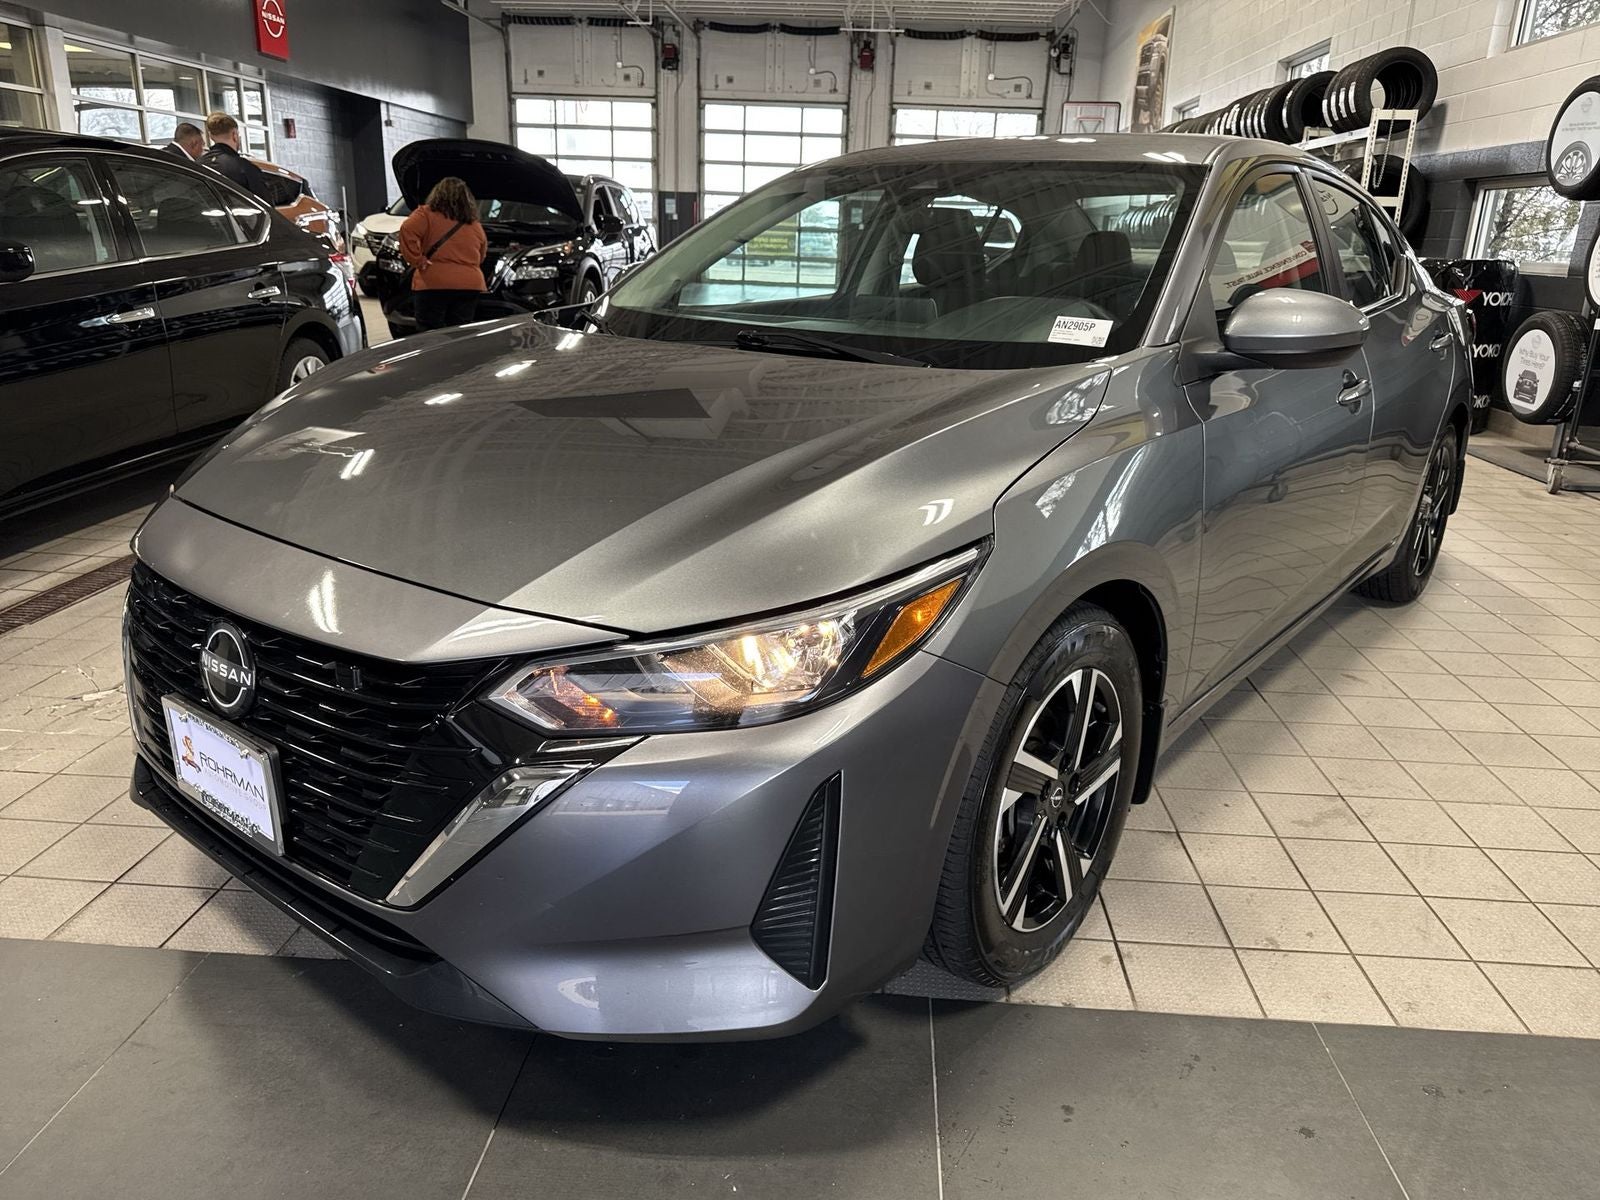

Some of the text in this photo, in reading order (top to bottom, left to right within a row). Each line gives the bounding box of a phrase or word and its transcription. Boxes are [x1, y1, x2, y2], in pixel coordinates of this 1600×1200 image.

[262, 11, 285, 24] NISSAN
[1055, 320, 1096, 331] AN2905P
[202, 650, 251, 686] NISSAN
[199, 751, 265, 802] ROHRMAN
